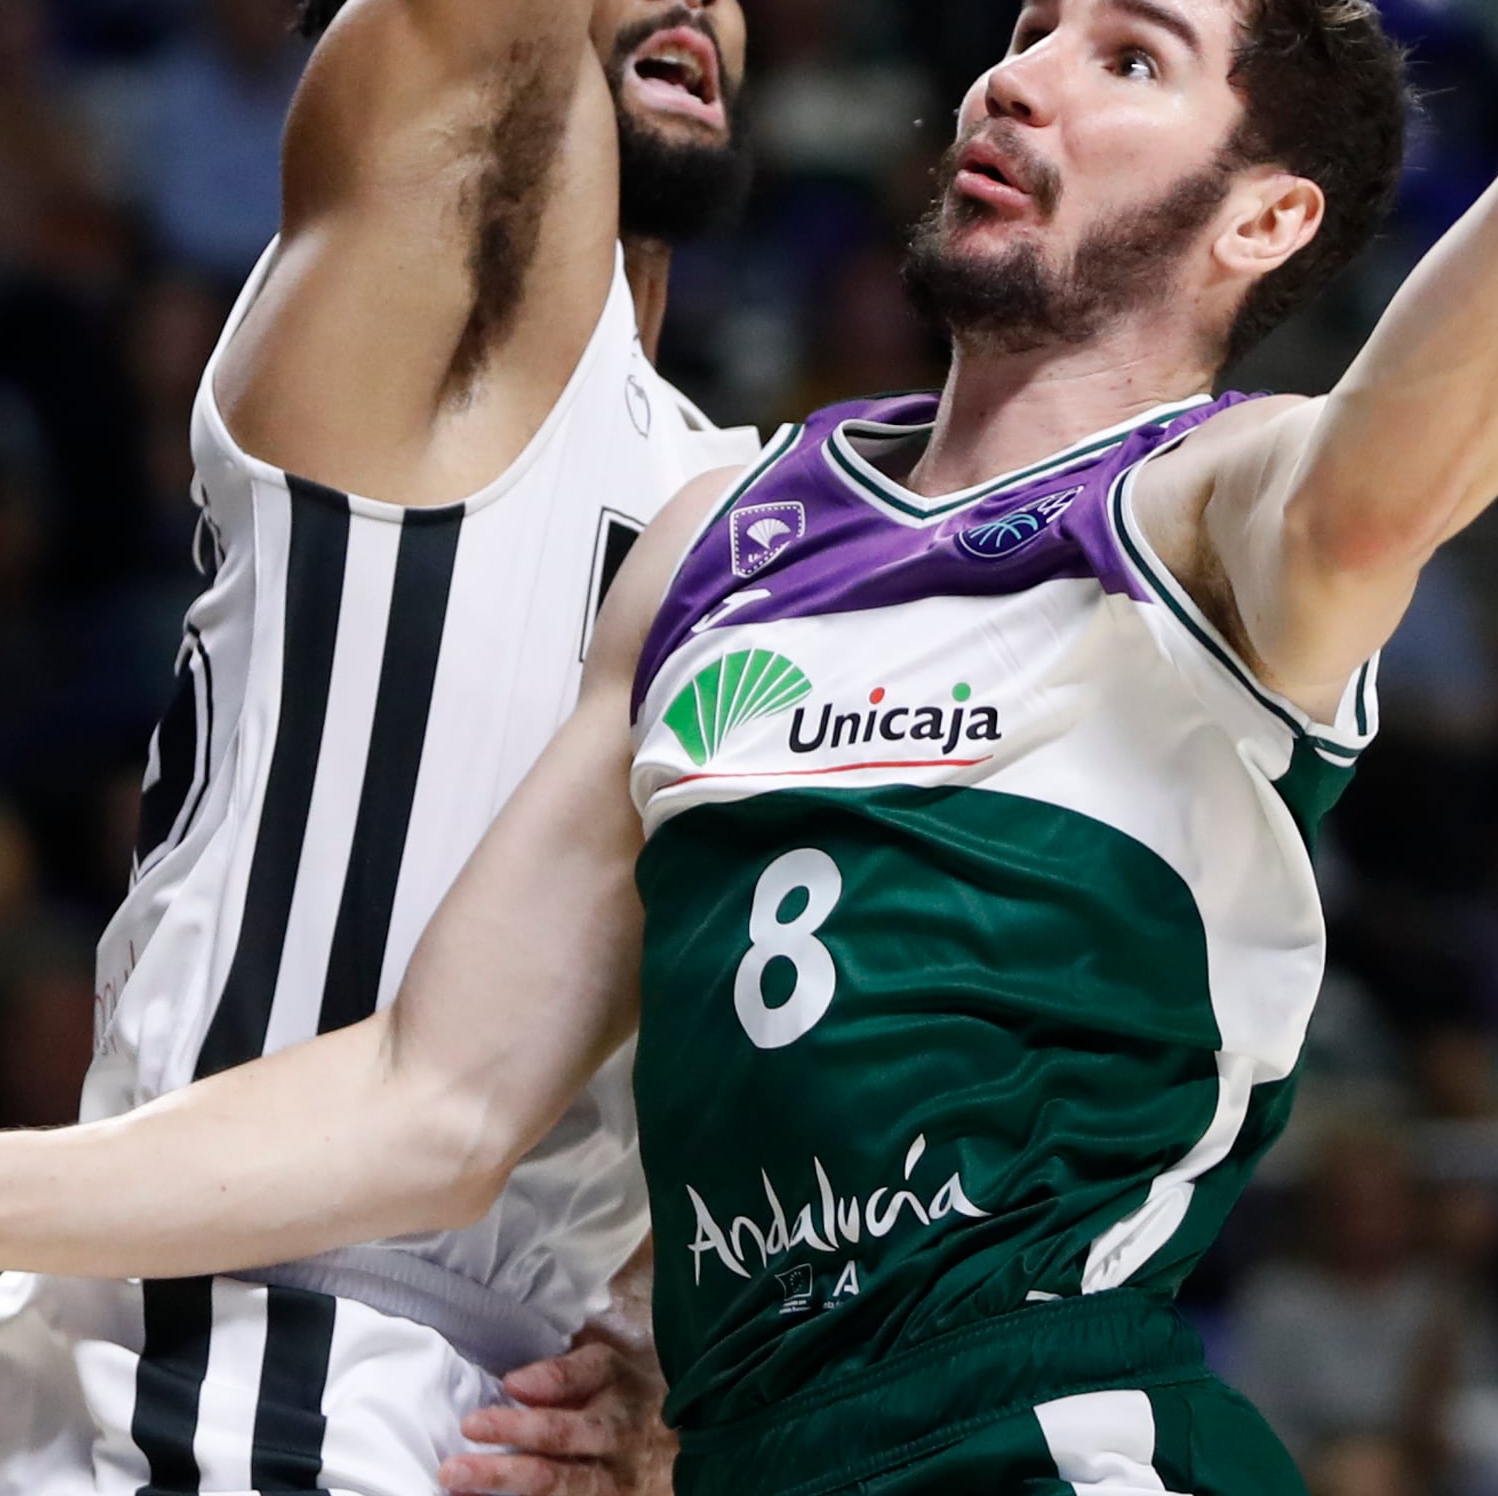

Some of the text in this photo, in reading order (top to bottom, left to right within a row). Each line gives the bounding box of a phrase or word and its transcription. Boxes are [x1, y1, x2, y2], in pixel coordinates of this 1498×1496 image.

[788, 683, 1002, 755] Unicaja
[734, 848, 842, 1049] 8
[686, 1134, 992, 1285] Andalucía
